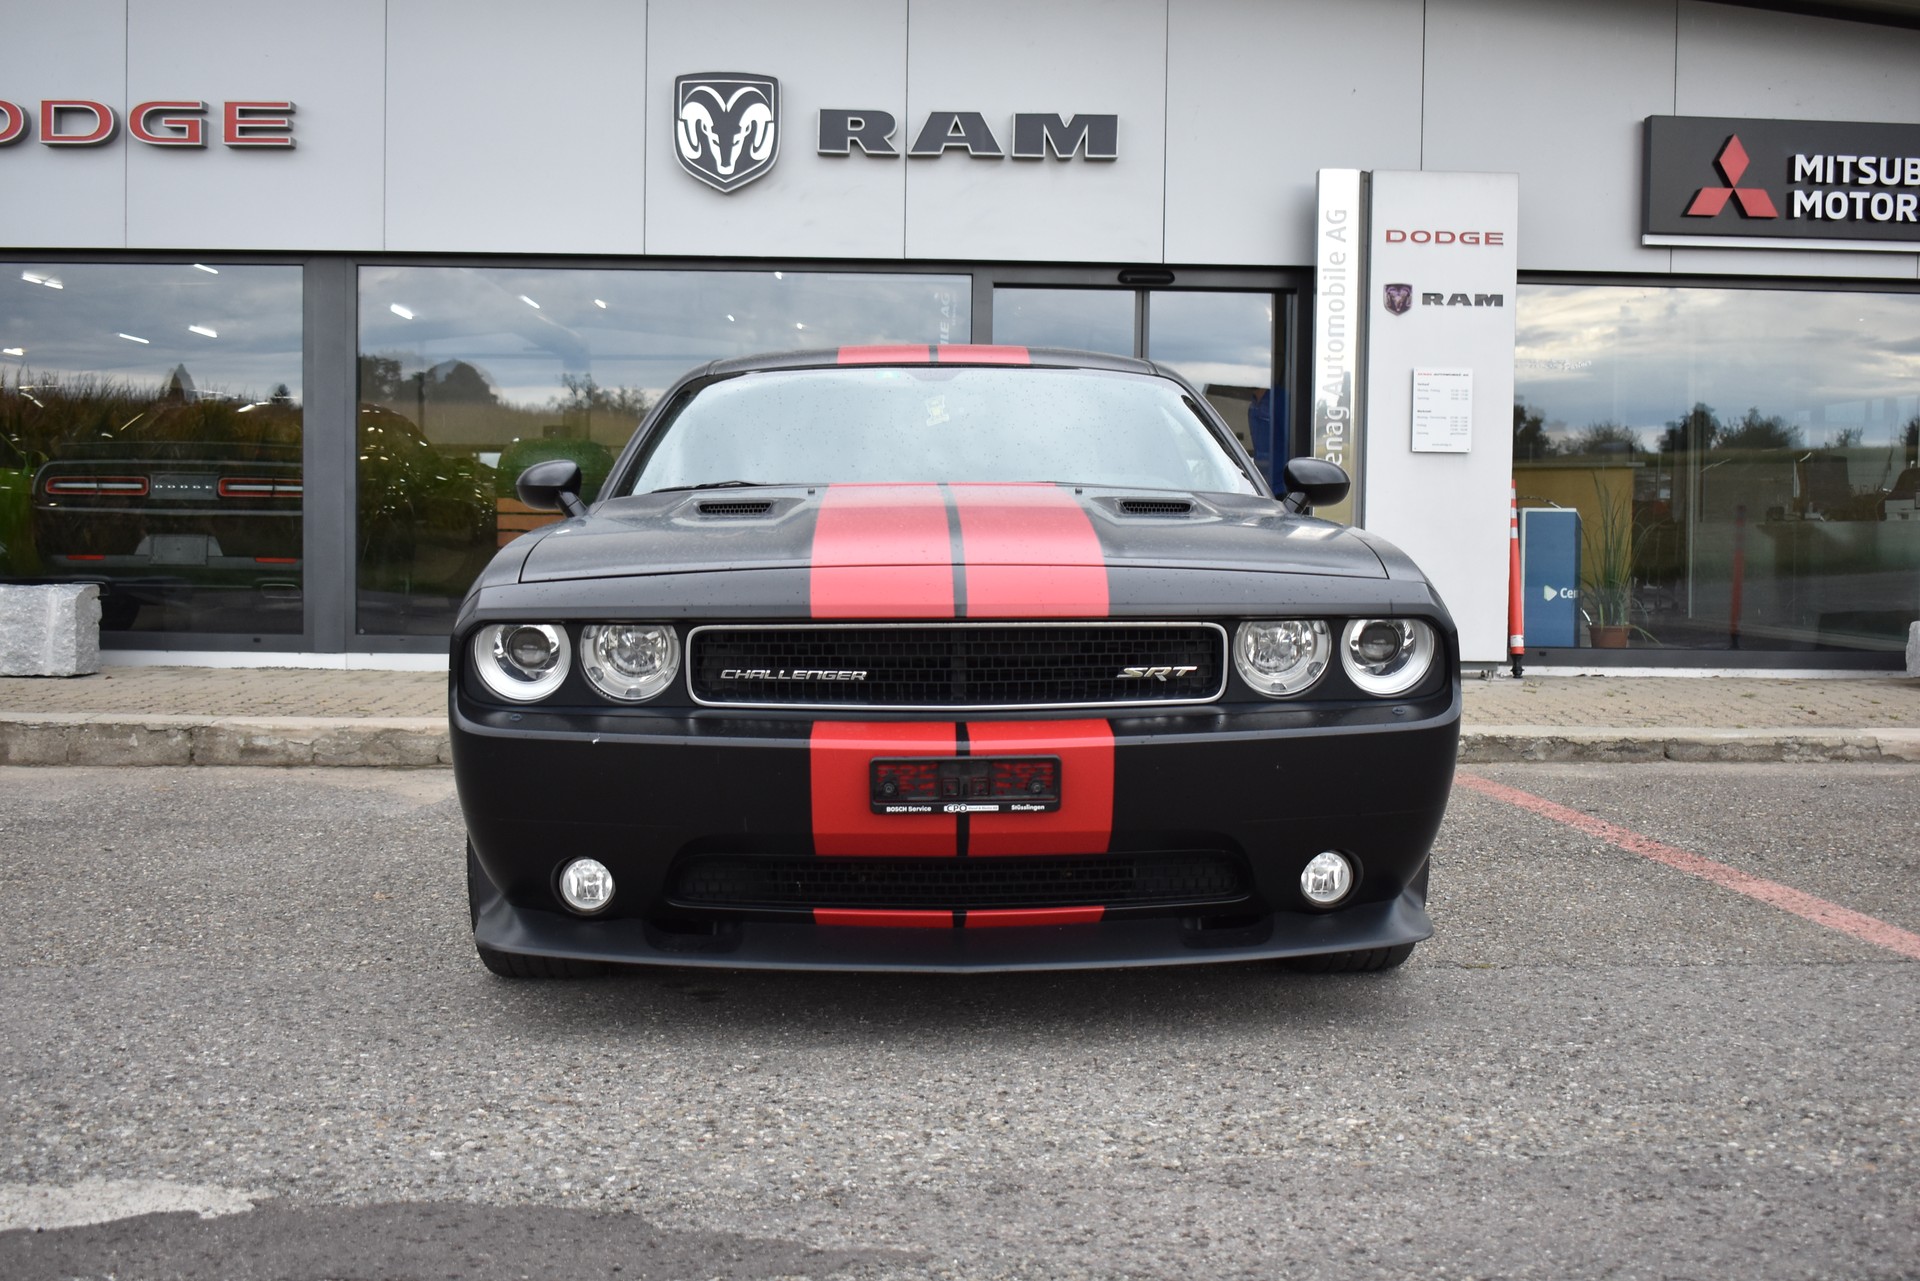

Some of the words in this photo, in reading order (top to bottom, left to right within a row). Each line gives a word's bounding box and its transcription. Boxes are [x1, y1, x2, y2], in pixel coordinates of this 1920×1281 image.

[817, 108, 1119, 161] RAM
[1794, 153, 1920, 186] MITSUB
[1793, 190, 1918, 222] MOTOR
[1325, 208, 1347, 243] AG
[1385, 229, 1504, 246] DODGE
[1421, 292, 1504, 307] RAM
[1322, 251, 1346, 397] Automobile
[720, 669, 867, 681] CHALLENGER
[1117, 665, 1198, 682] SRT
